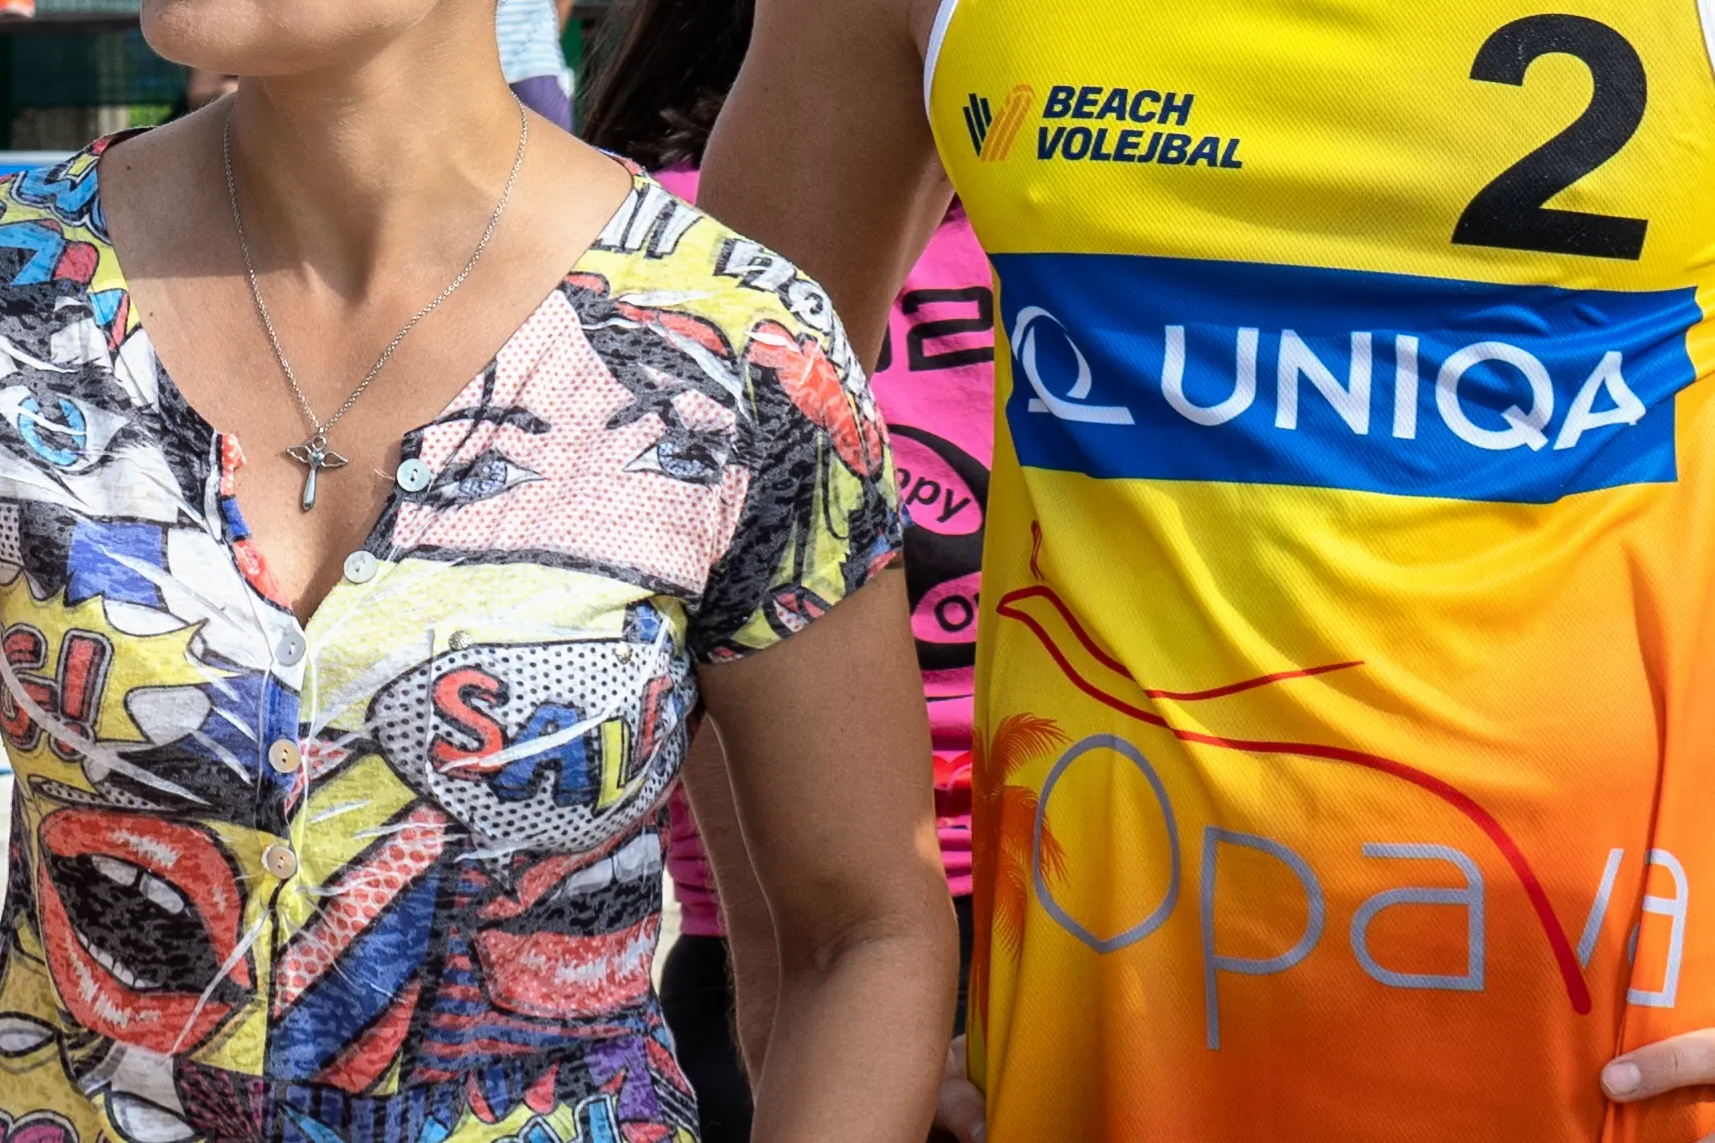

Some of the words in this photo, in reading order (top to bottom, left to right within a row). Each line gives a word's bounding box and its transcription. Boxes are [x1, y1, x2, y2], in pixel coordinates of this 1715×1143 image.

[1037, 126, 1243, 169] VOLEJBAL
[1042, 85, 1194, 126] BEACH
[1451, 13, 1649, 261] 2
[1161, 324, 1647, 453] UNIQA
